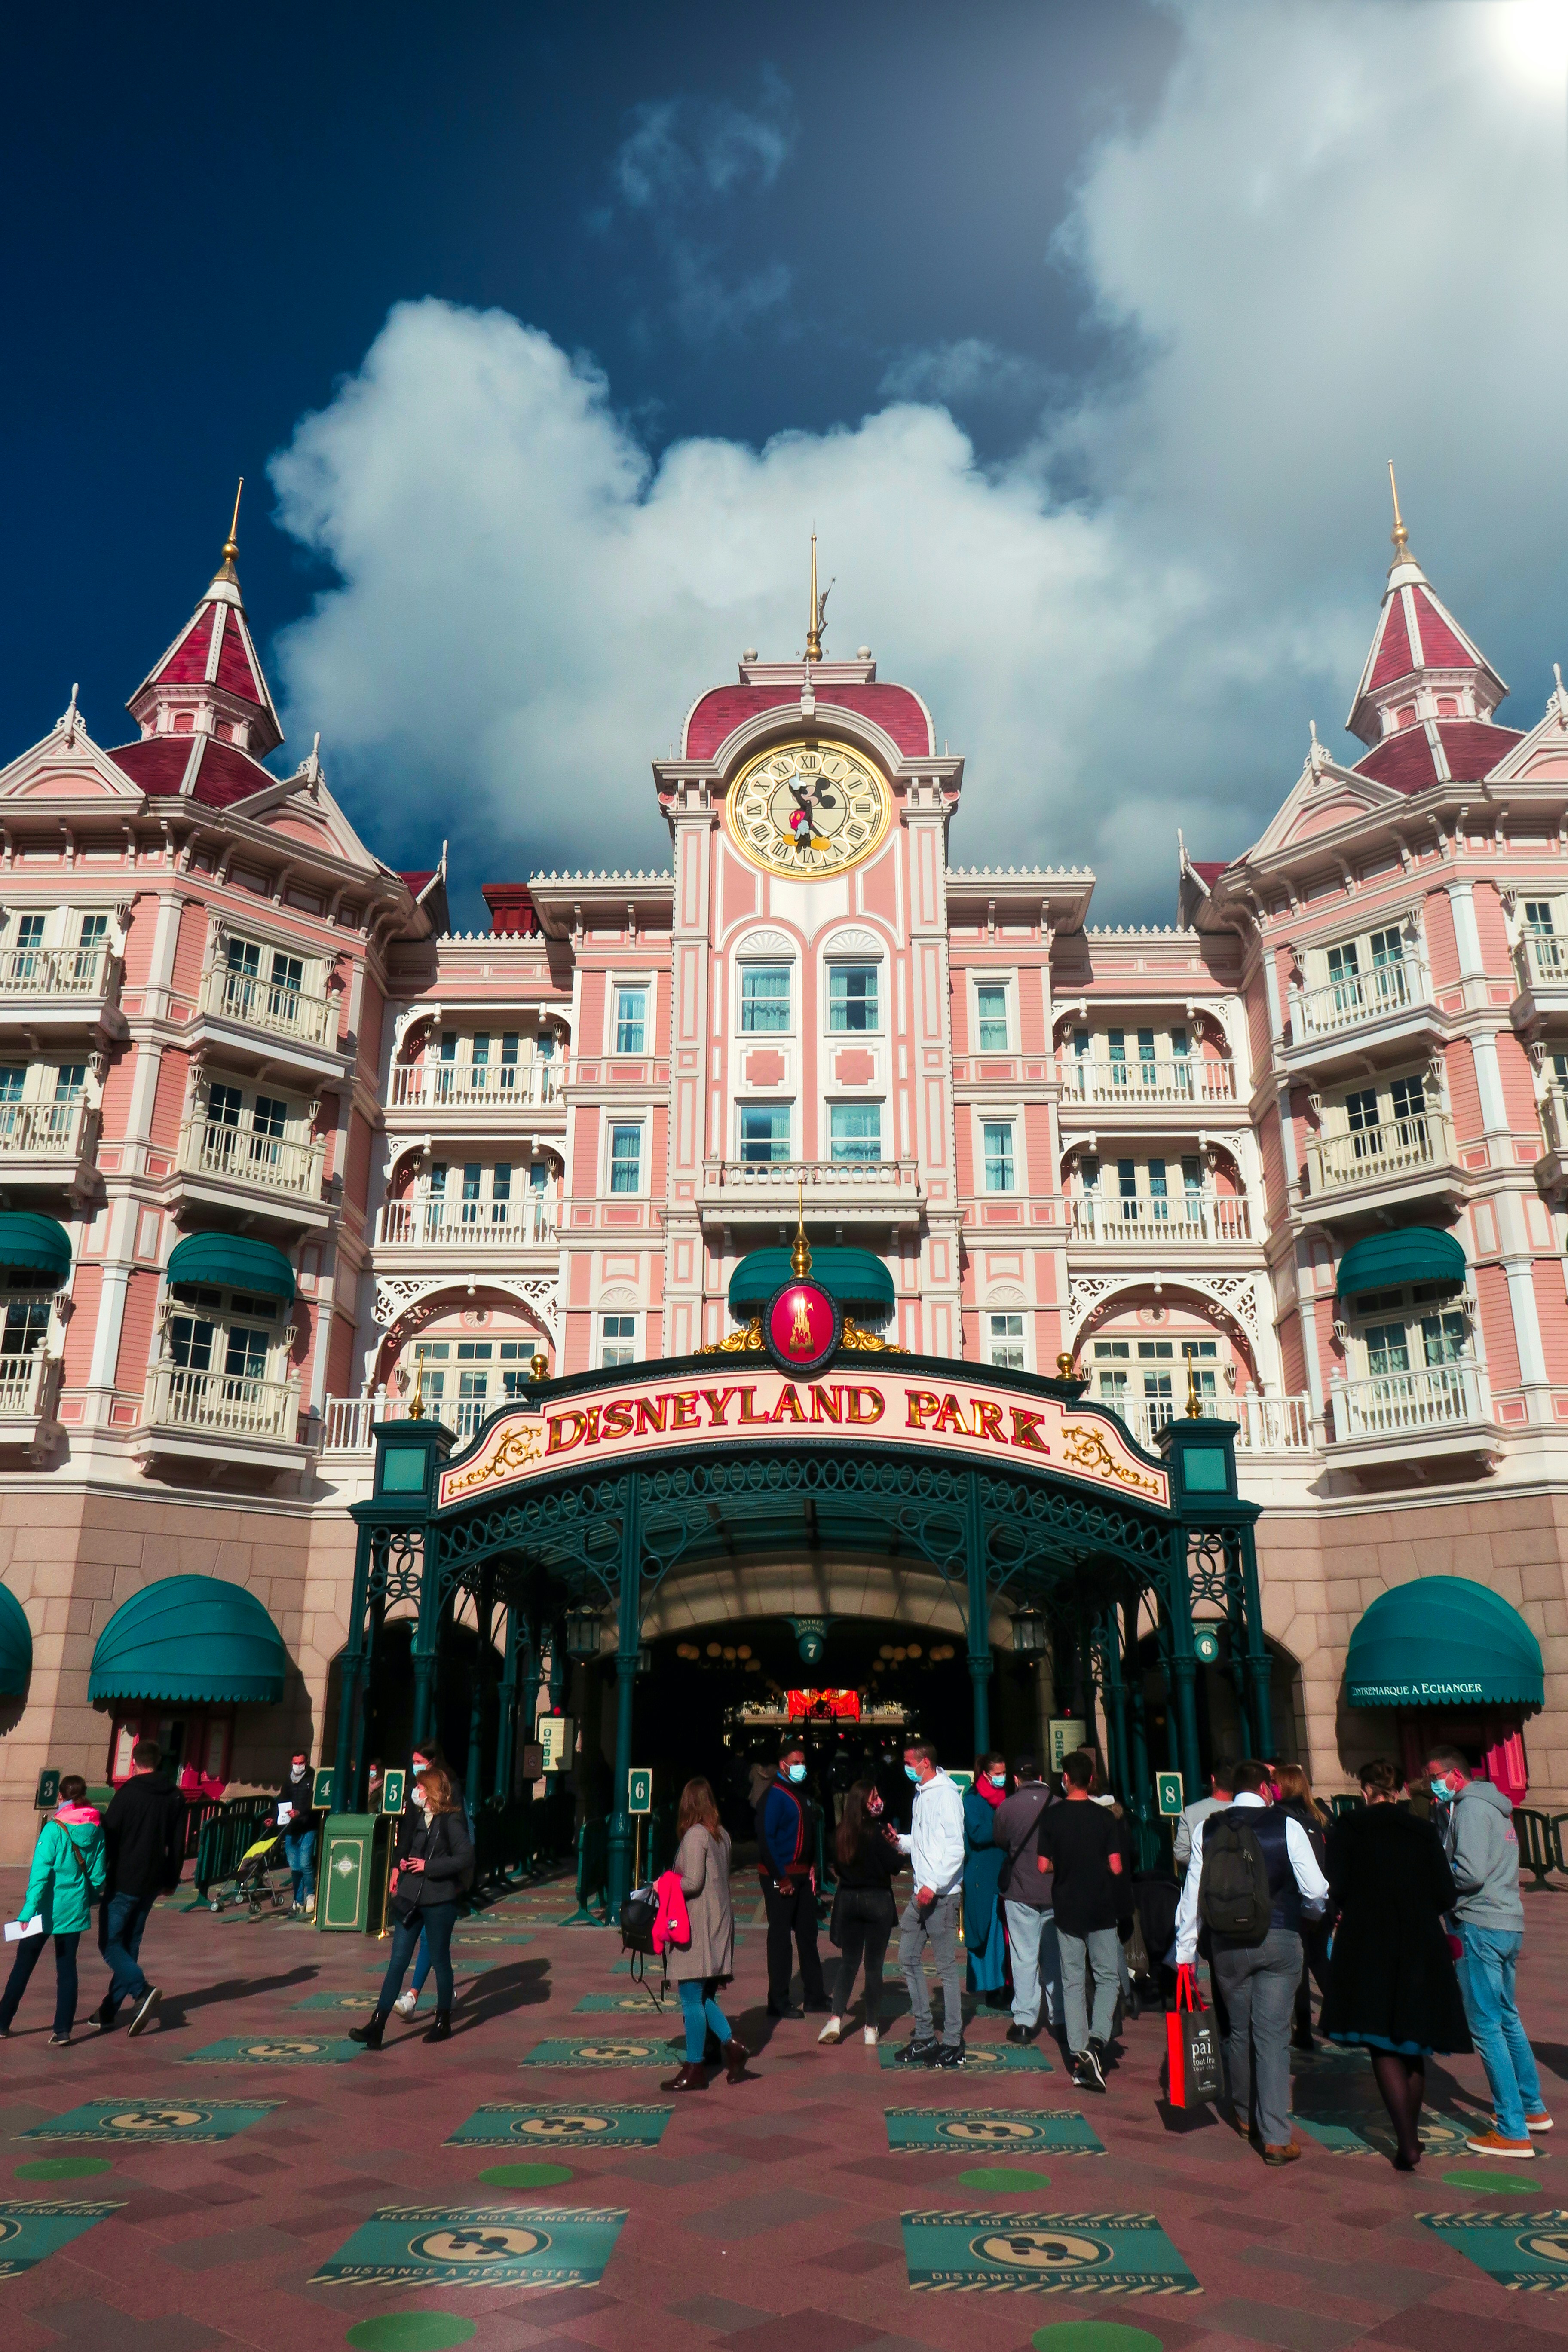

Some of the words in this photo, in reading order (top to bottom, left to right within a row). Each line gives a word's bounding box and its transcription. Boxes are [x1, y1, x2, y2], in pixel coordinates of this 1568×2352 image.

[773, 761, 790, 777] XI
[801, 756, 816, 769] XII
[754, 781, 770, 792] X
[848, 779, 862, 790] II
[747, 804, 761, 815] IX
[856, 804, 870, 812] III
[752, 824, 770, 842] VIII
[847, 824, 865, 839] IIII
[772, 842, 789, 859] VII
[833, 844, 844, 857] V
[545, 1384, 885, 1456] DISNEYLAND
[905, 1388, 1050, 1455] PARK
[807, 1643, 817, 1658] 7
[1201, 1640, 1212, 1655] 6
[1421, 1683, 1482, 1694] ECHANGER
[44, 1781, 54, 1797] 3
[320, 1780, 331, 1797] 4
[389, 1784, 398, 1802] 5
[635, 1782, 644, 1799] 6
[1165, 1785, 1176, 1804] 8
[1191, 2039, 1213, 2059] pai
[341, 2266, 437, 2275] DISTANCE
[445, 2267, 457, 2276] A
[468, 2268, 580, 2278] RESPECTER
